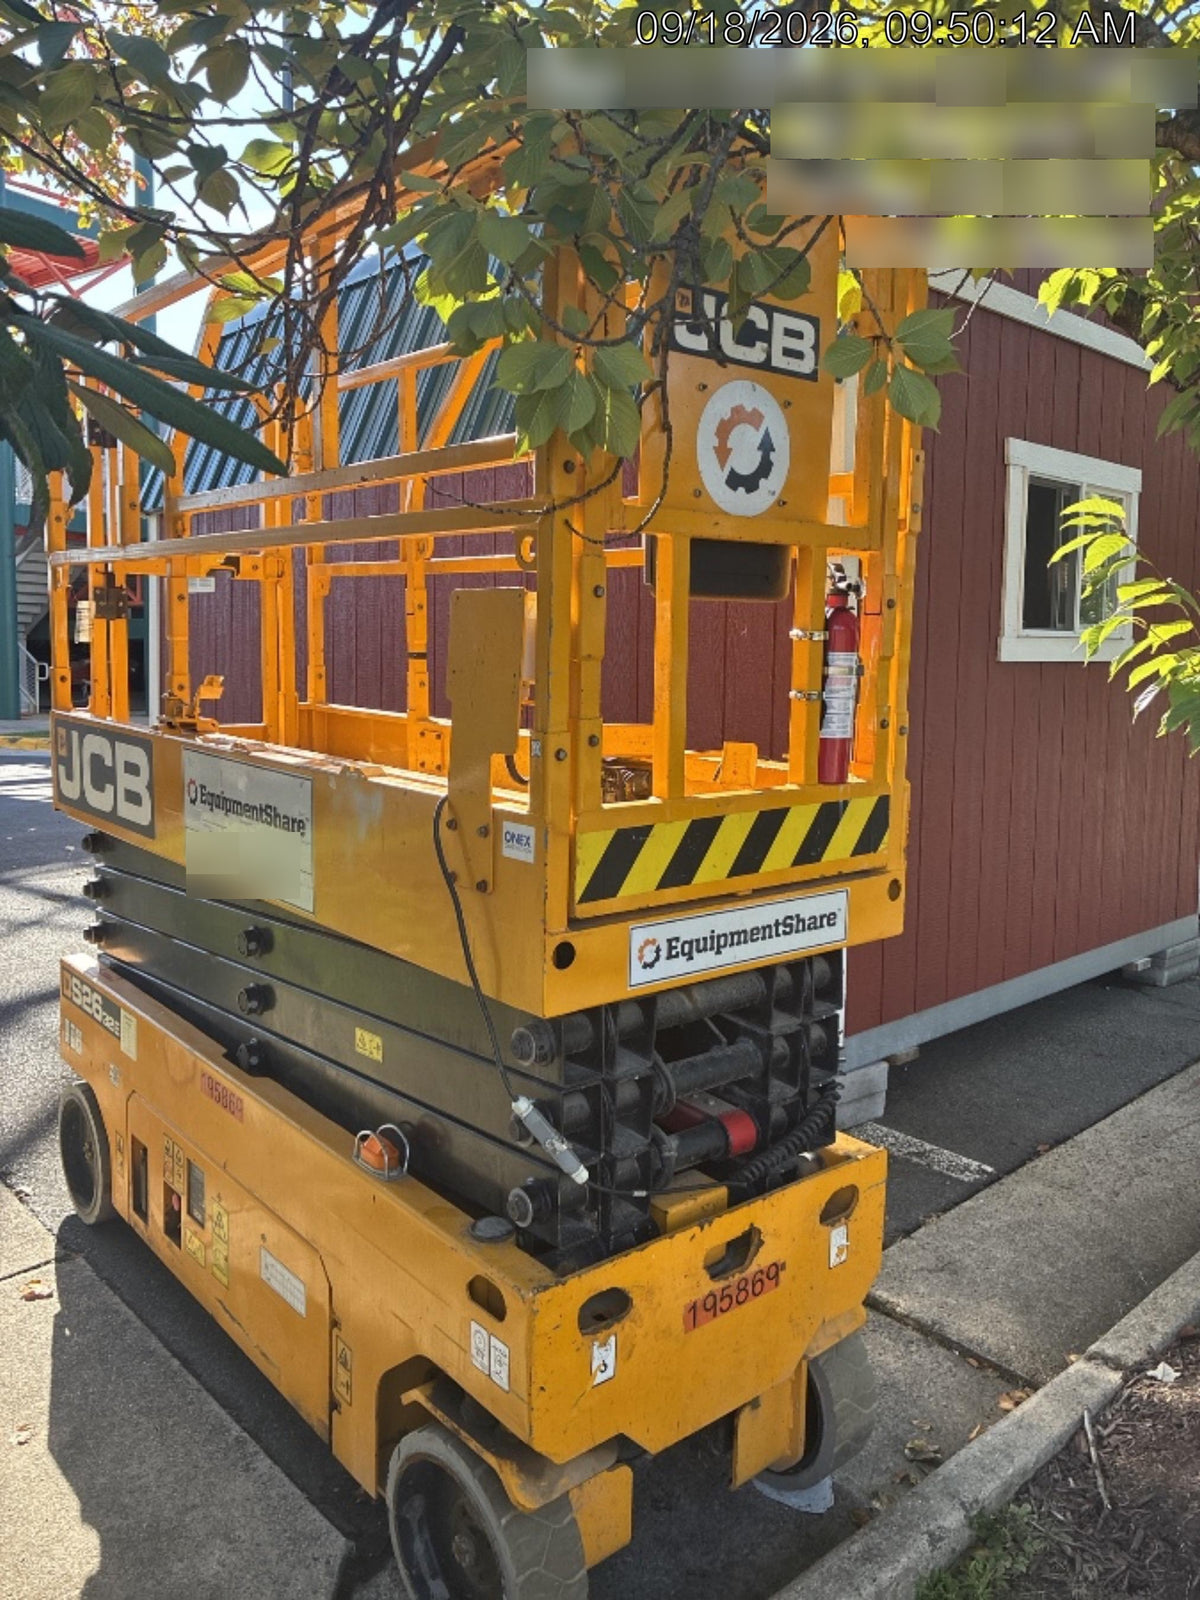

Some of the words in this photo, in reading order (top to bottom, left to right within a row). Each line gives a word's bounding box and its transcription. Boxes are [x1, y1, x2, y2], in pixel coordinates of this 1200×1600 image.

[674, 293, 816, 374] JCB
[58, 730, 152, 826] JCB
[199, 783, 306, 838] EquipmentShare
[665, 910, 838, 962] EquipmentShare
[687, 1261, 780, 1329] 195869
